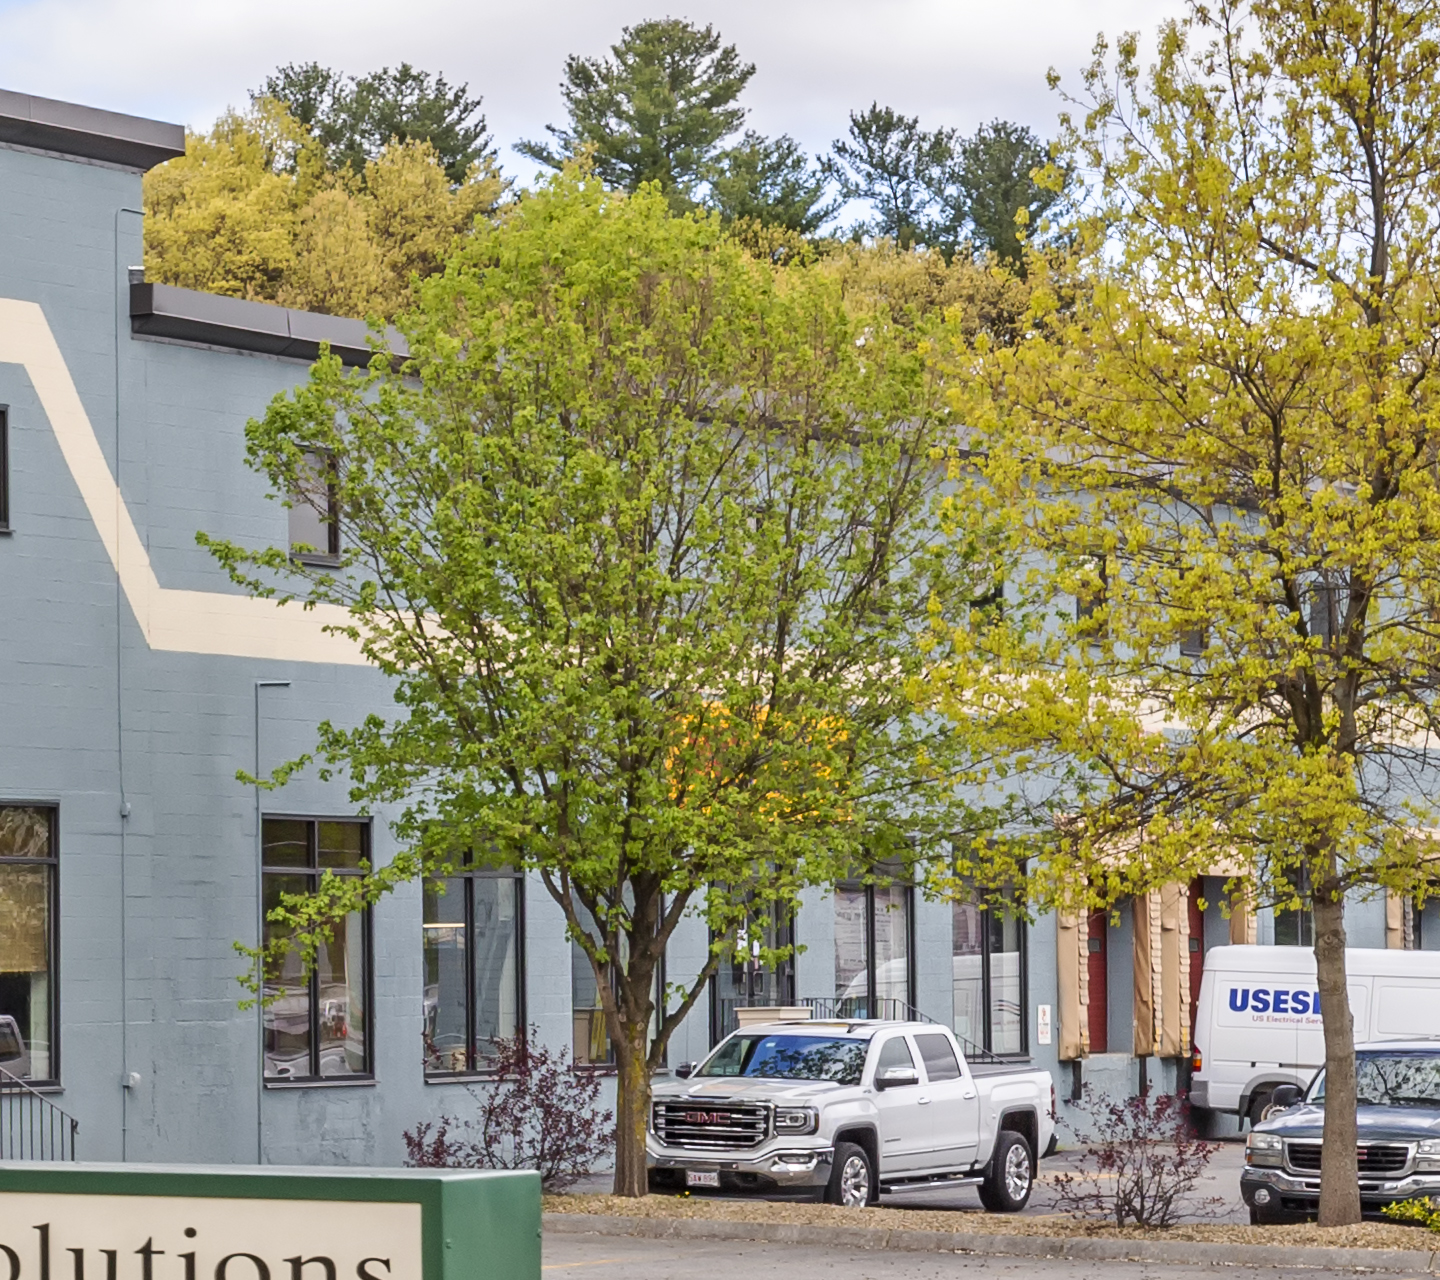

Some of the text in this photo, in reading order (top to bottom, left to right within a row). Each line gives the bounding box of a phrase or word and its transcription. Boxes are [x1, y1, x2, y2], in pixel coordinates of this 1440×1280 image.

[1252, 1014, 1264, 1023] US
[1267, 1015, 1304, 1025] Electrical
[685, 1111, 731, 1125] GMC
